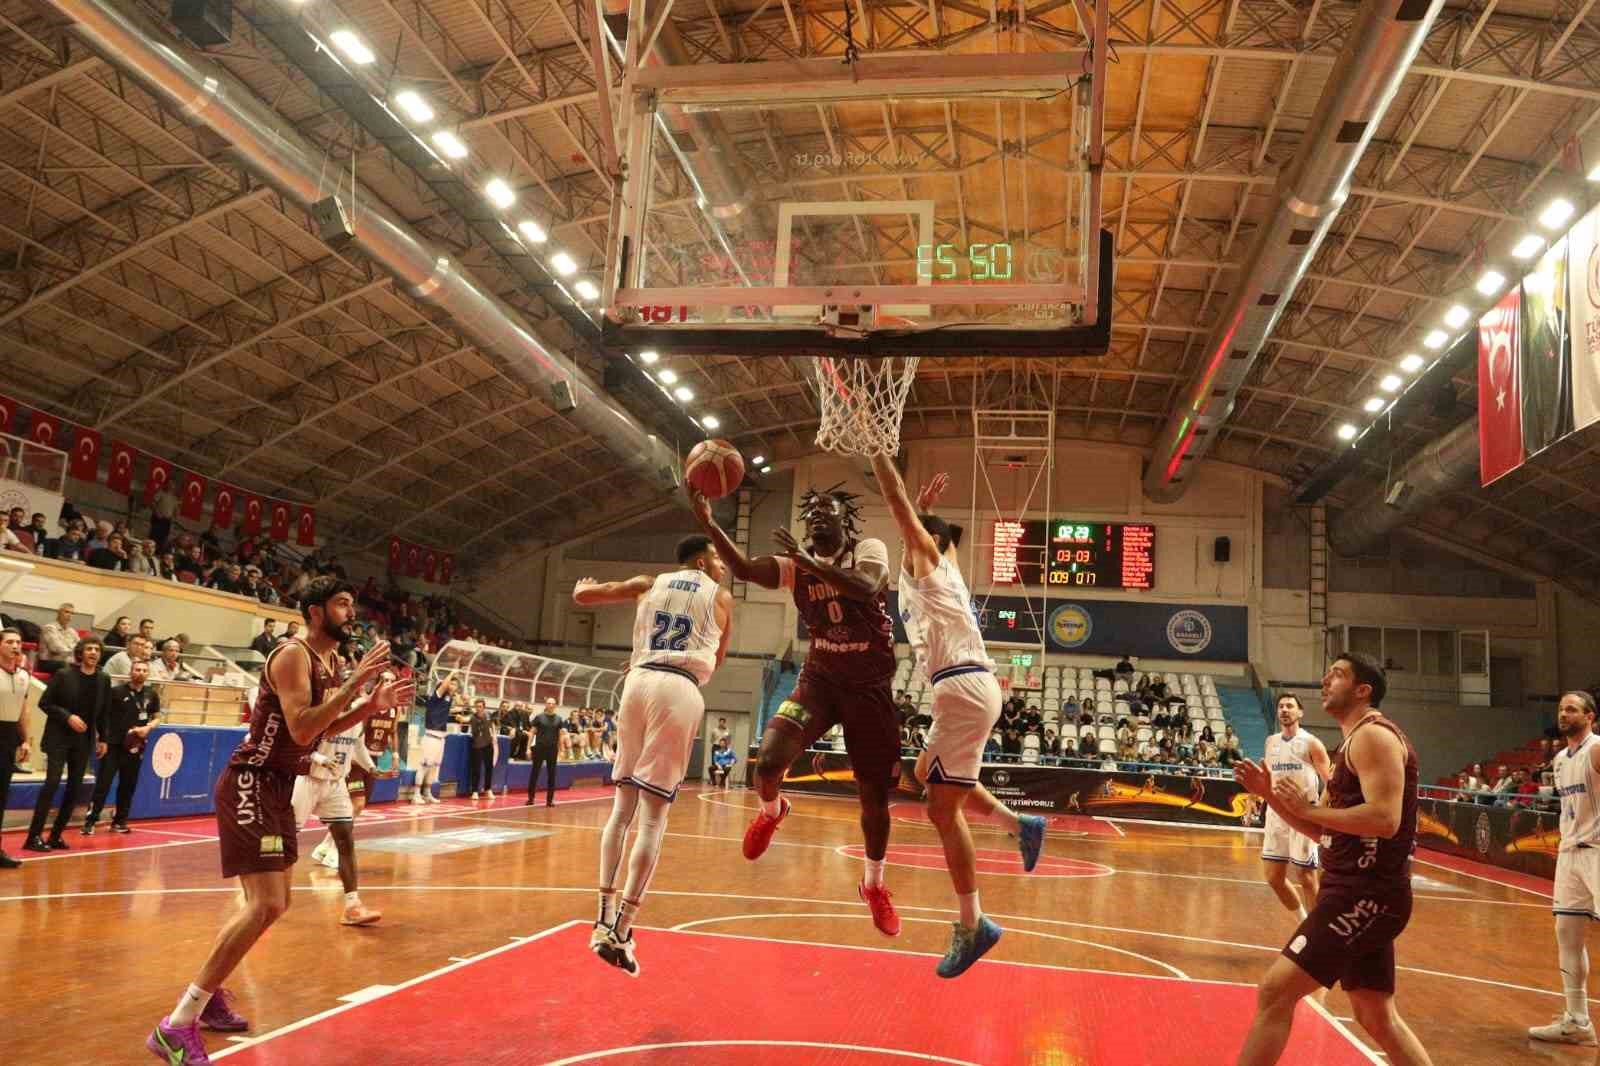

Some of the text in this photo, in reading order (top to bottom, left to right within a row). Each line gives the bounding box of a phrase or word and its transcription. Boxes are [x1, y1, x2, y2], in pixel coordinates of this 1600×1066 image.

[667, 579, 701, 593] HUNT
[649, 610, 694, 651] 22
[827, 600, 844, 624] 0
[248, 711, 281, 768] Sultan
[237, 770, 256, 827] UMG
